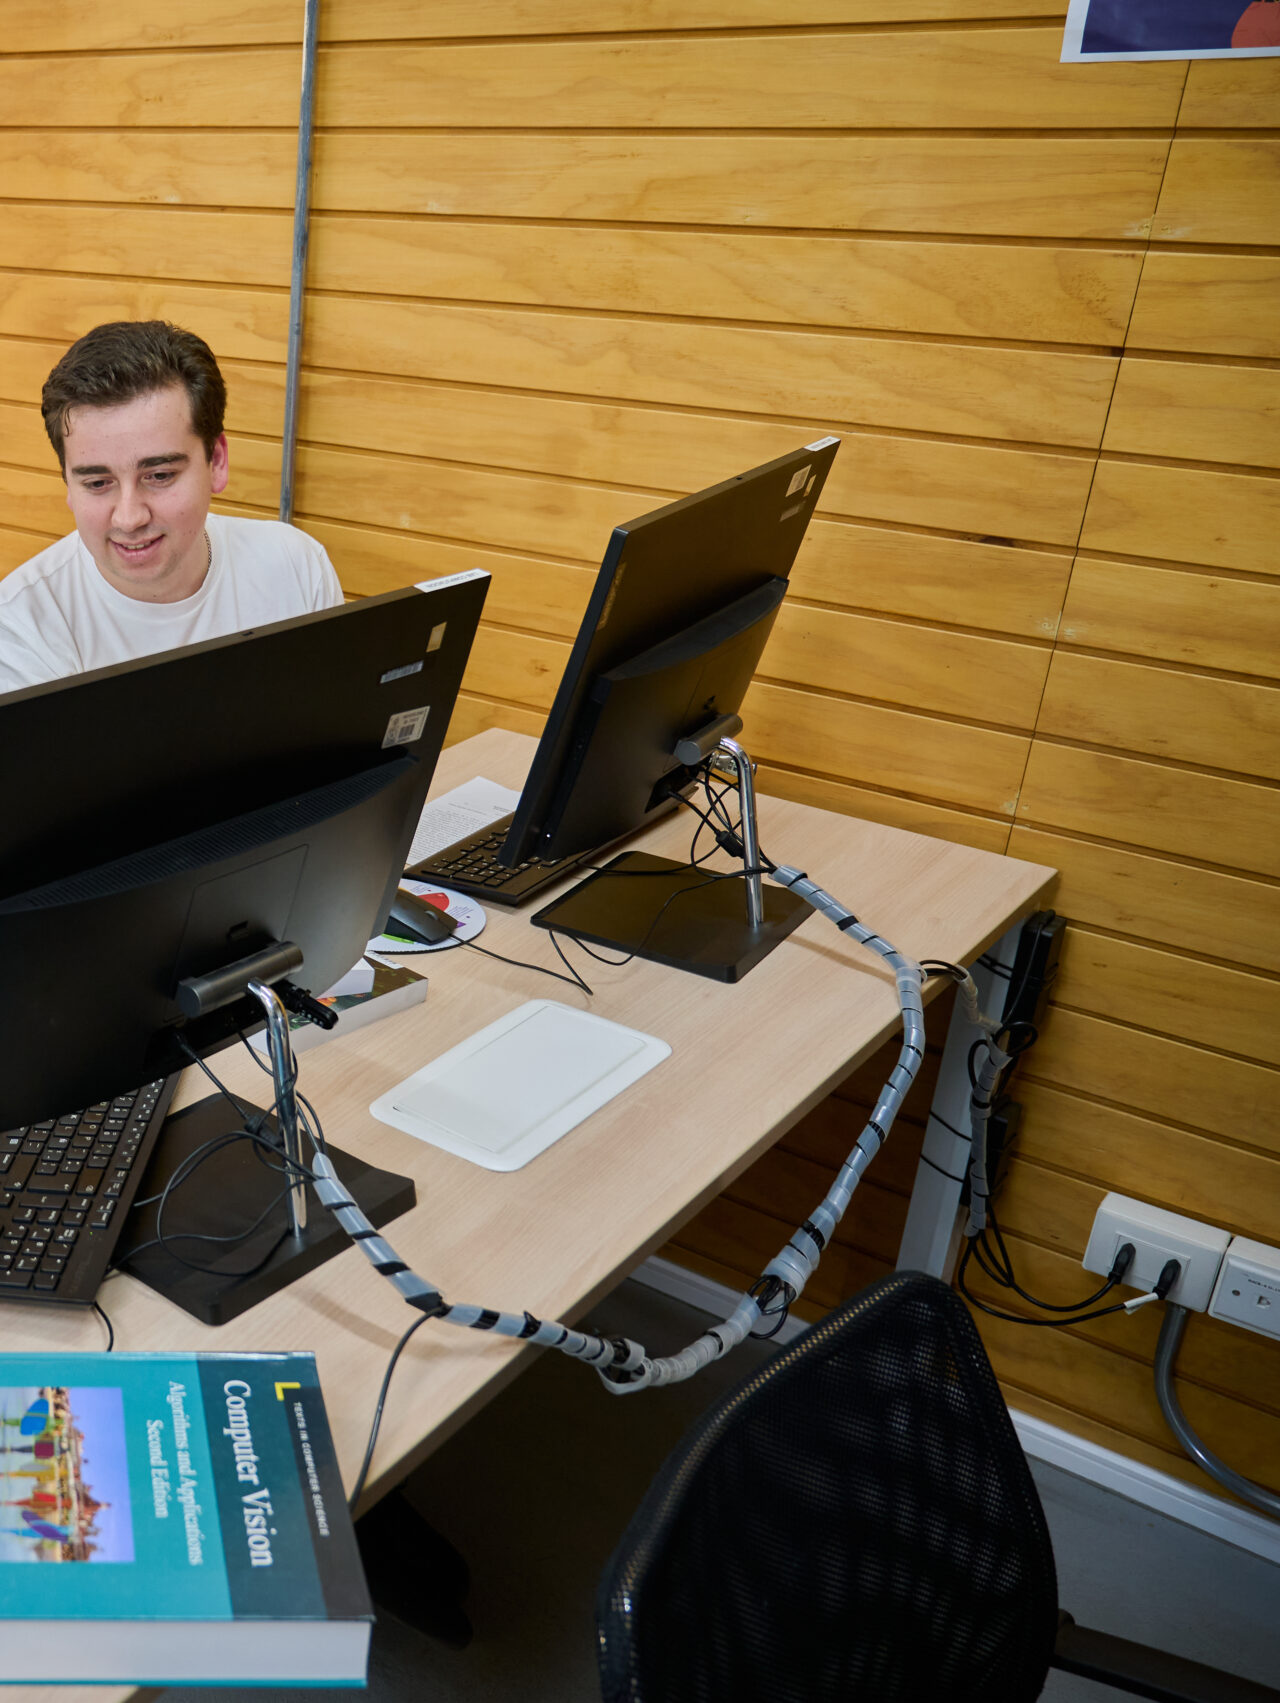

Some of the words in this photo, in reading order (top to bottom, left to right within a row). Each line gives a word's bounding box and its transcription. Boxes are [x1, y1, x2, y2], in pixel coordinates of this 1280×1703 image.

[166, 1380, 191, 1449] Algorithms
[293, 1402, 306, 1429] TEXTS
[299, 1429, 309, 1441] IN
[146, 1419, 169, 1466] Second
[176, 1450, 197, 1476] and
[302, 1441, 320, 1492] COMPUTER
[151, 1467, 173, 1518] Edition
[222, 1379, 260, 1486] Computer
[241, 1487, 278, 1568] Vision
[176, 1475, 205, 1566] Applications
[312, 1493, 330, 1537] SCIENCE
